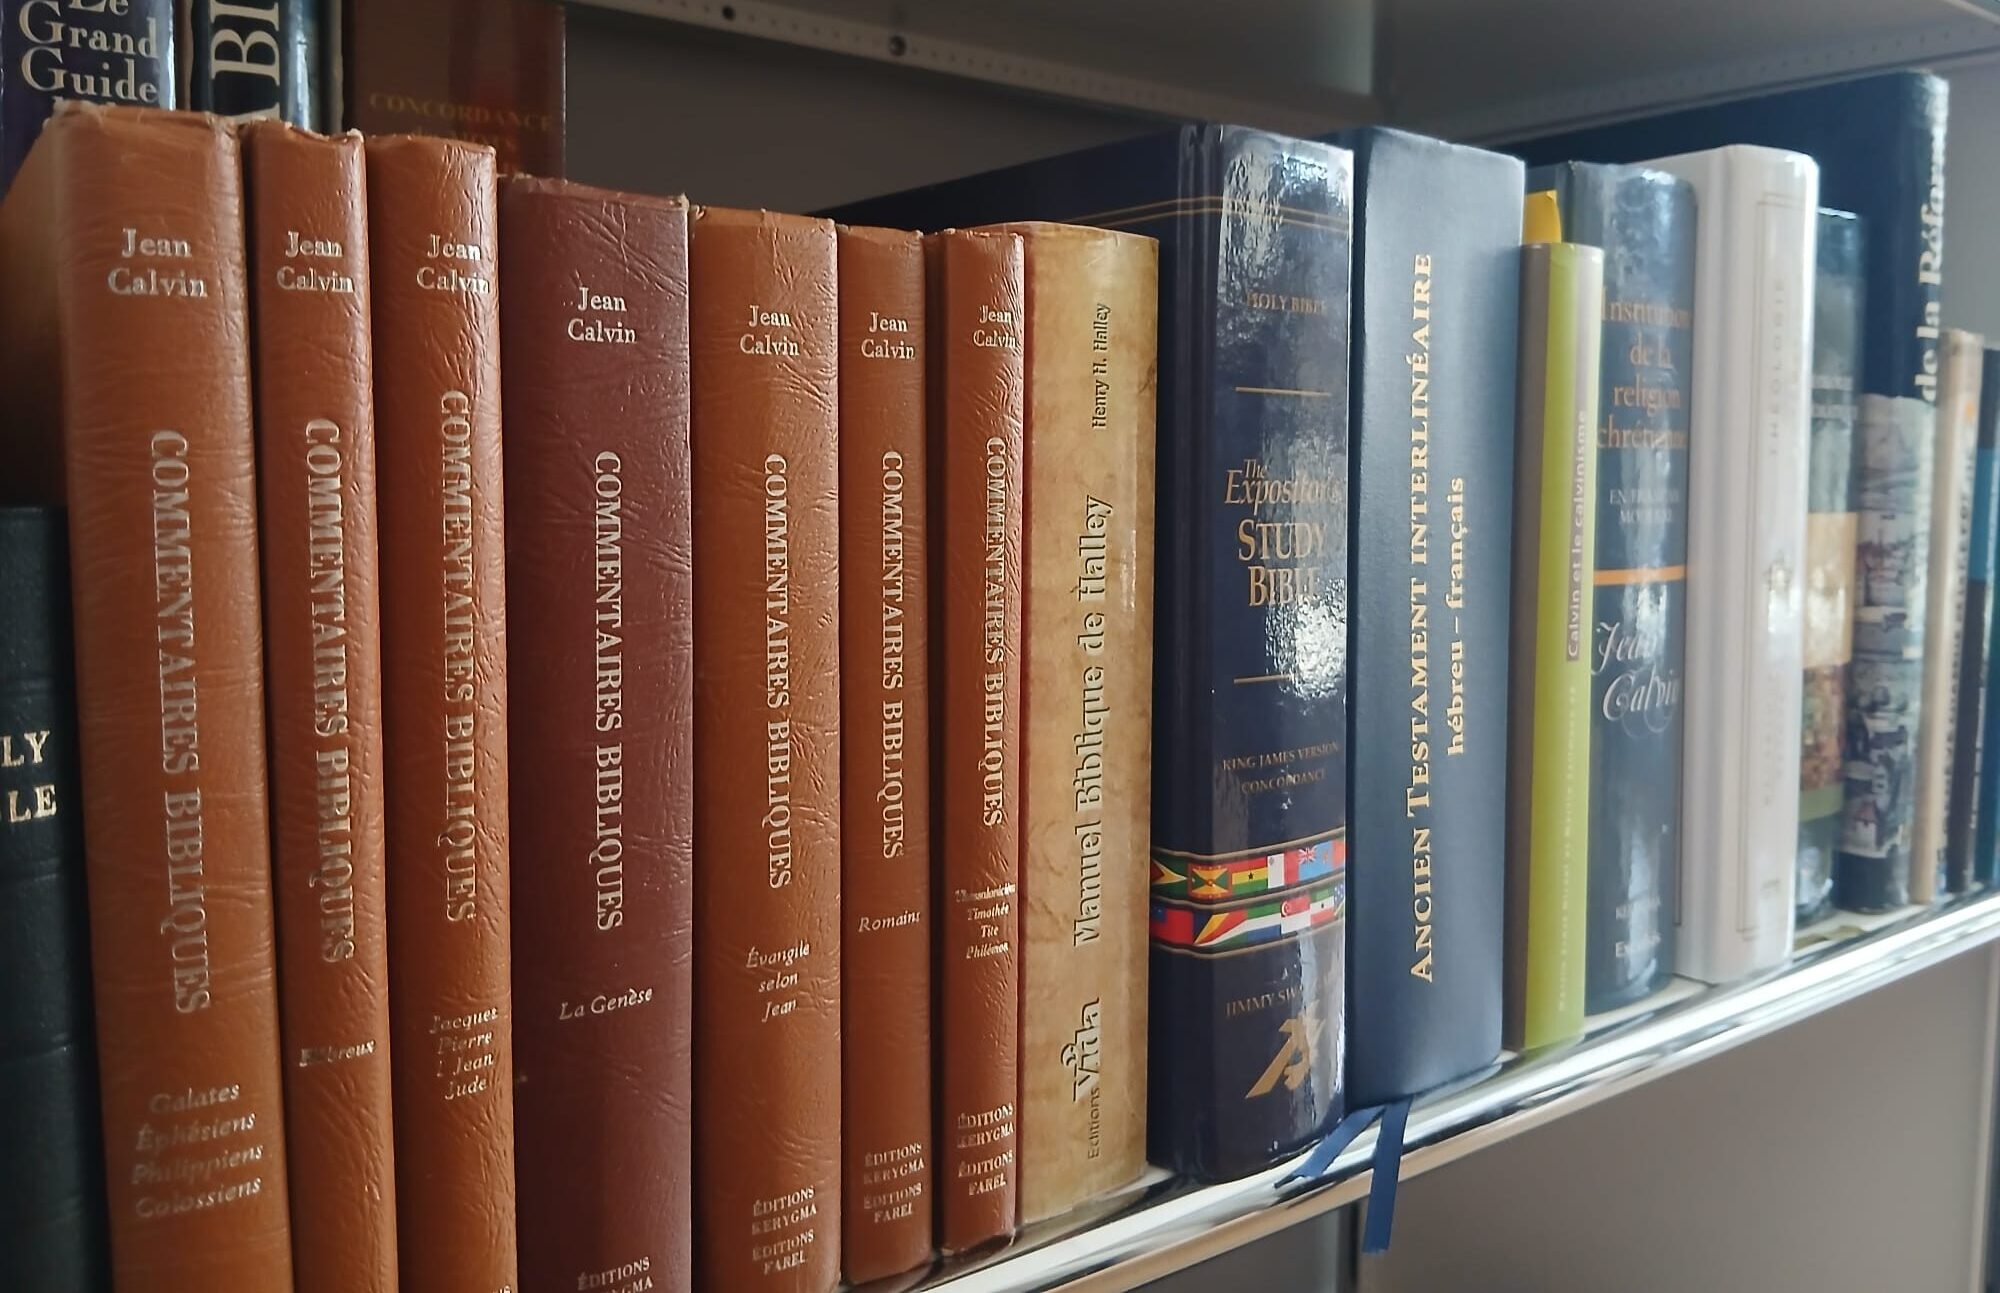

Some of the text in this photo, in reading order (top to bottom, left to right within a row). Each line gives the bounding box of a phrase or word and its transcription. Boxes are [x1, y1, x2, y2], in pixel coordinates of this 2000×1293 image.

[19, 0, 159, 59] Grand
[21, 46, 159, 102] Guide
[122, 228, 192, 258] Jean
[285, 230, 343, 258] Jean
[427, 234, 481, 261] Jean
[107, 266, 208, 298] Calvin
[276, 266, 355, 294] Calvin
[416, 266, 490, 295] Calvin
[577, 287, 628, 312] Jean
[1247, 292, 1288, 310] HOLY
[748, 304, 791, 328] Jean
[868, 311, 908, 334] Jean
[979, 305, 1012, 324] Jean
[1916, 300, 1940, 339] la
[567, 317, 637, 345] Calvin
[972, 329, 1016, 349] Calvin
[740, 335, 800, 357] Calvin
[861, 338, 916, 361] Calvin
[1629, 330, 1650, 366] de
[1092, 302, 1111, 429] Henry H. Halley
[1914, 349, 1937, 403] de
[1613, 373, 1682, 418] religion
[1244, 459, 1266, 480] The
[1237, 518, 1327, 562] STUDY
[1446, 476, 1468, 609] français
[1567, 410, 1587, 658] Calvin et le calvinisme
[1248, 565, 1321, 607] BIBLE
[977, 436, 1006, 827] COMMENTAIRES BIBLIQUES
[1405, 254, 1433, 984] ANCIEN TESTAMENT INTERLINÉAIRE
[438, 390, 476, 923] COMMENTAIRES BIBLIQUES
[876, 450, 904, 860] COMMENTAIRES BIBLIQUES
[761, 453, 792, 890] COMMENTAIRES BIBLIQUES
[305, 418, 355, 964] COMMENTAIRES BIBLIQUES
[588, 450, 624, 932] COMMENTAIRES BIBLIQUES
[1446, 639, 1465, 757] hébreu
[151, 429, 210, 1015] COMMENTAIRES BIBLIQUES
[1073, 494, 1113, 947] Manuel Biblique de Halley
[1222, 741, 1338, 771] KING JAMES VERSION
[1241, 768, 1326, 794] CONCORDANCE
[857, 910, 921, 933] Romains
[967, 902, 1010, 921] Timothée
[980, 925, 999, 938] Tite
[746, 941, 811, 970] Évangile
[758, 972, 799, 994] selon
[559, 986, 653, 1020] La Genèse
[761, 998, 797, 1022] Jean
[1225, 995, 1273, 1019] JIMMY
[452, 1053, 494, 1077] Jean
[444, 1075, 487, 1100] Jude
[956, 1121, 1015, 1150] KERYGMA
[863, 1157, 926, 1185] KERYGMA
[968, 1172, 1007, 1197] FAREL
[753, 1185, 815, 1217] ÉDITIONS
[577, 1256, 650, 1291] ÉDITIONS
[763, 1250, 806, 1275] FAREL
